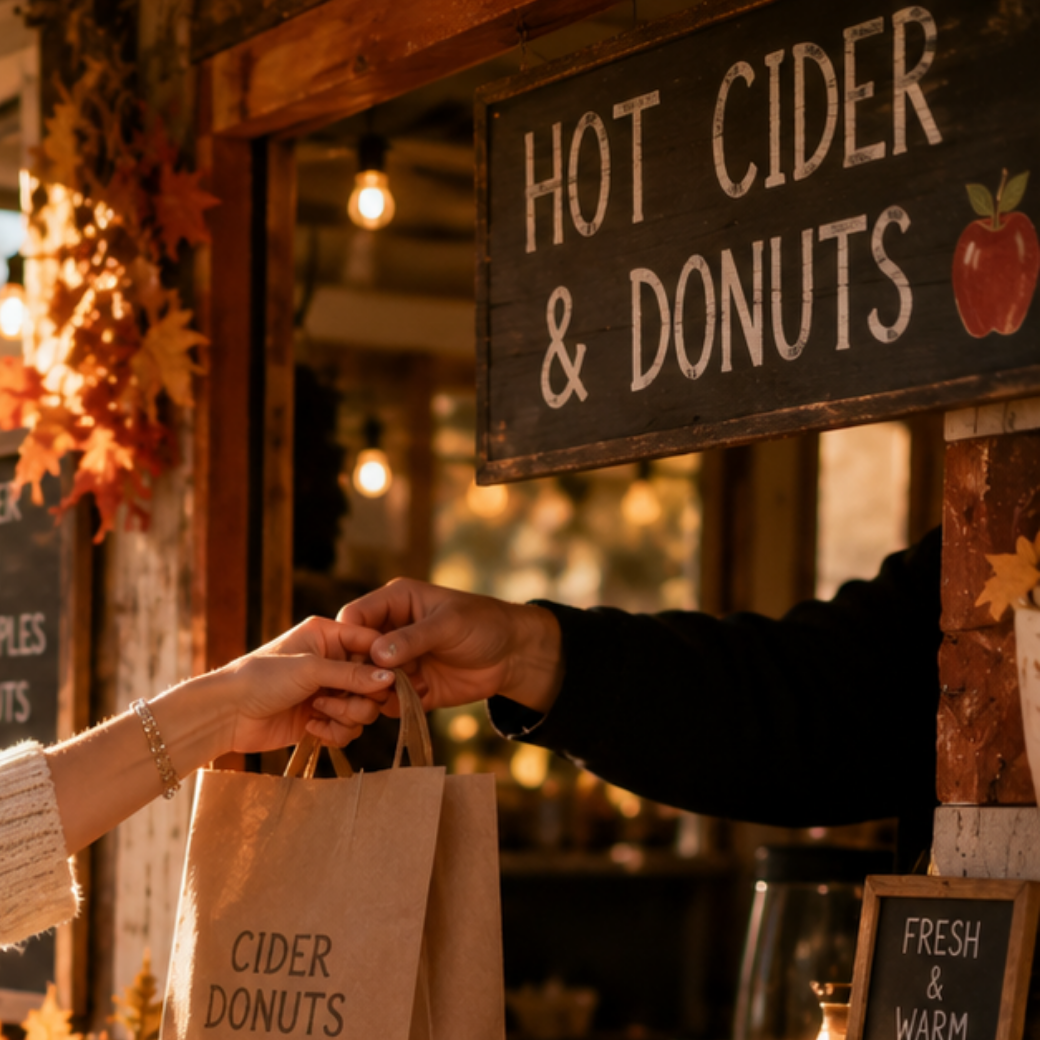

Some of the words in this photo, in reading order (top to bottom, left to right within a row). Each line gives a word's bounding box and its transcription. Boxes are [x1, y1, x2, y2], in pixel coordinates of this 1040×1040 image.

[525, 90, 660, 253] HOT
[713, 5, 943, 198] CIDER
[540, 285, 588, 409] &
[629, 204, 913, 392] DONUTS
[231, 930, 333, 978] CIDER
[902, 917, 981, 959] FRESH
[926, 965, 943, 1001] &
[204, 984, 346, 1037] DONUTS
